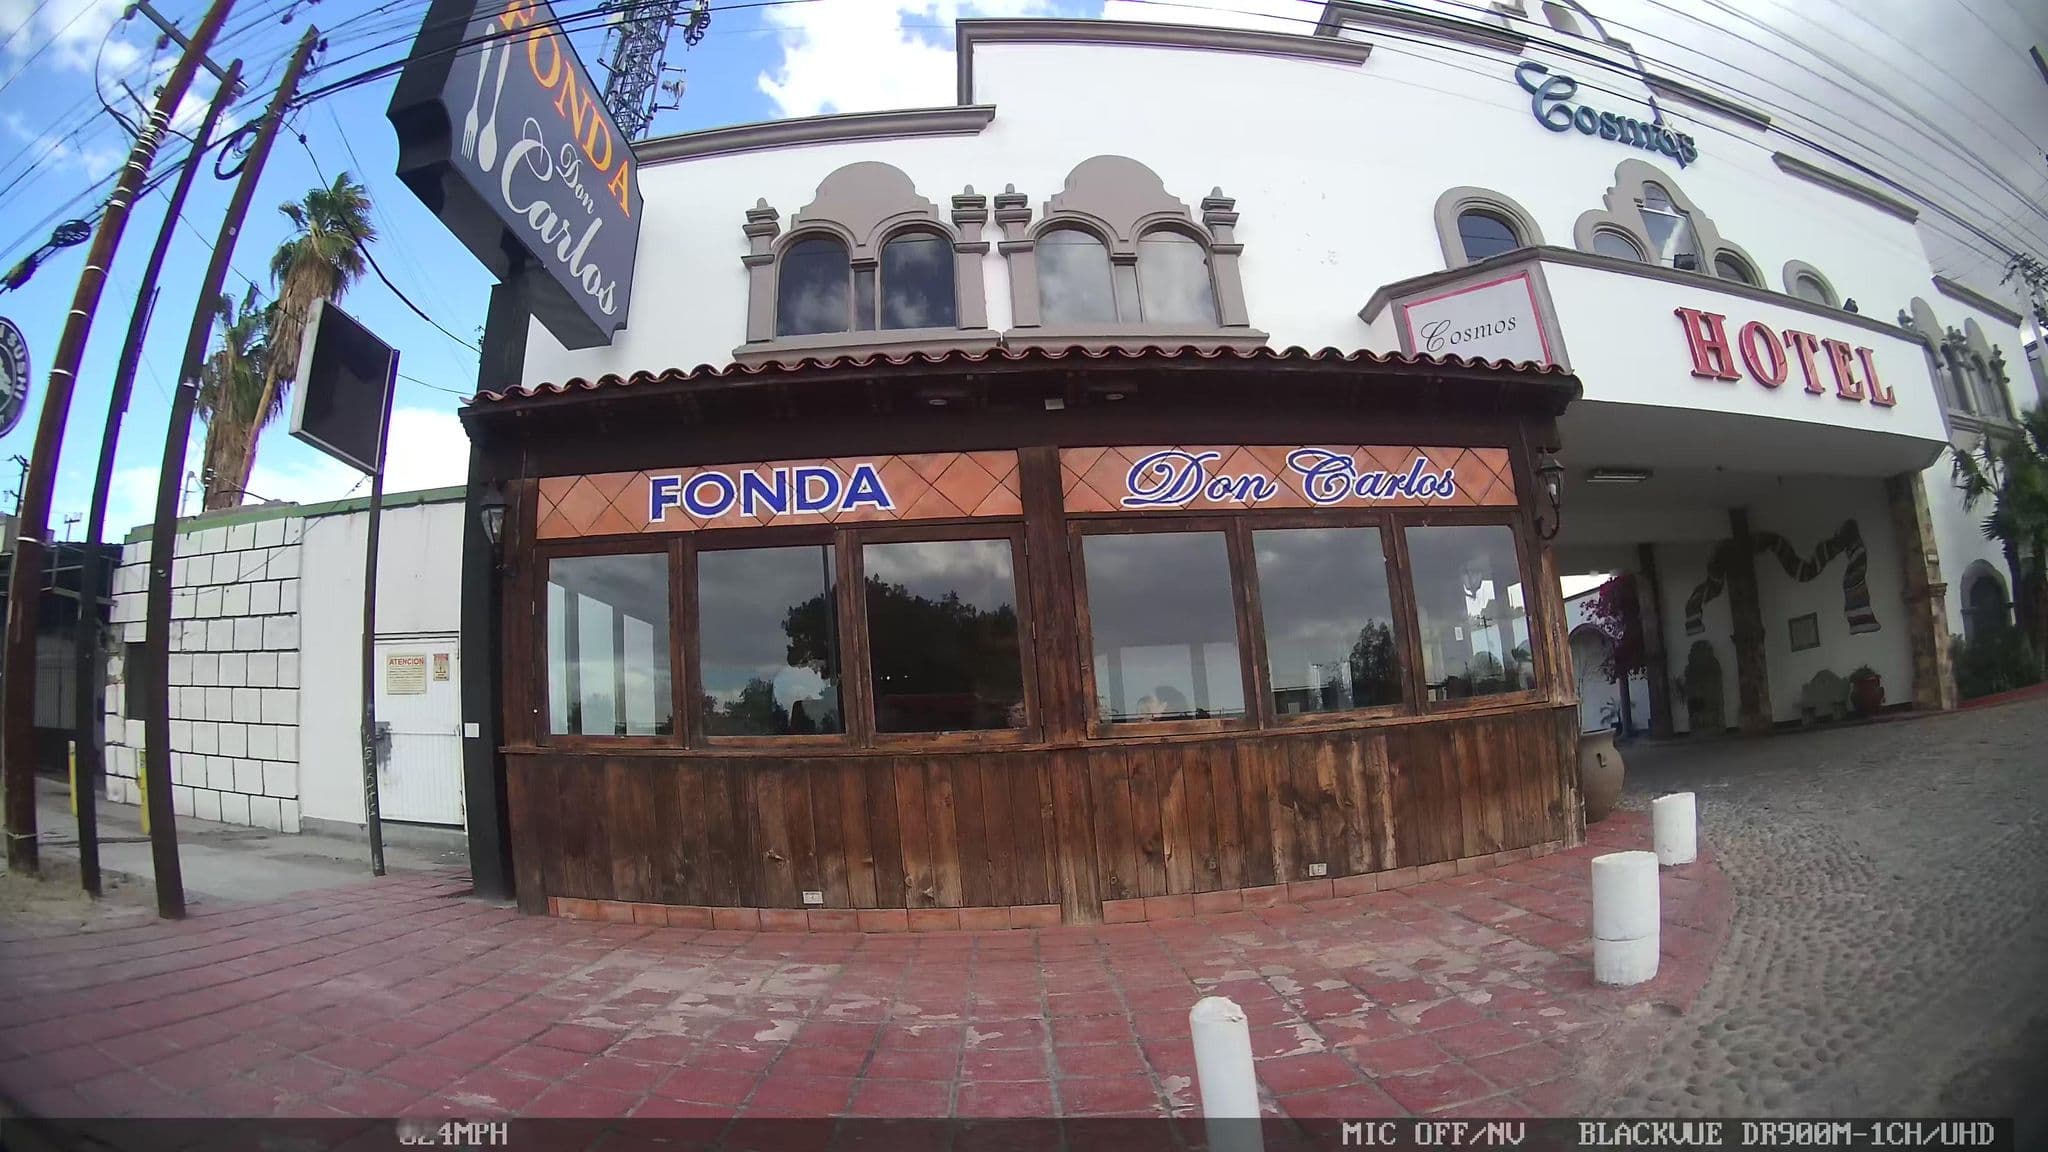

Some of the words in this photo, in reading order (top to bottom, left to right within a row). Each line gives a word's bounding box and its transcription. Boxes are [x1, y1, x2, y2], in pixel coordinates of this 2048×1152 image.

[1515, 60, 1698, 169] Cosmos
[556, 143, 595, 215] Don
[501, 117, 617, 316] Carlos
[1420, 316, 1517, 353] Cosmos
[1674, 306, 1897, 409] HOTEL
[650, 463, 897, 523] FONDA
[1120, 450, 1279, 508] Don
[1286, 448, 1457, 504] Carlos
